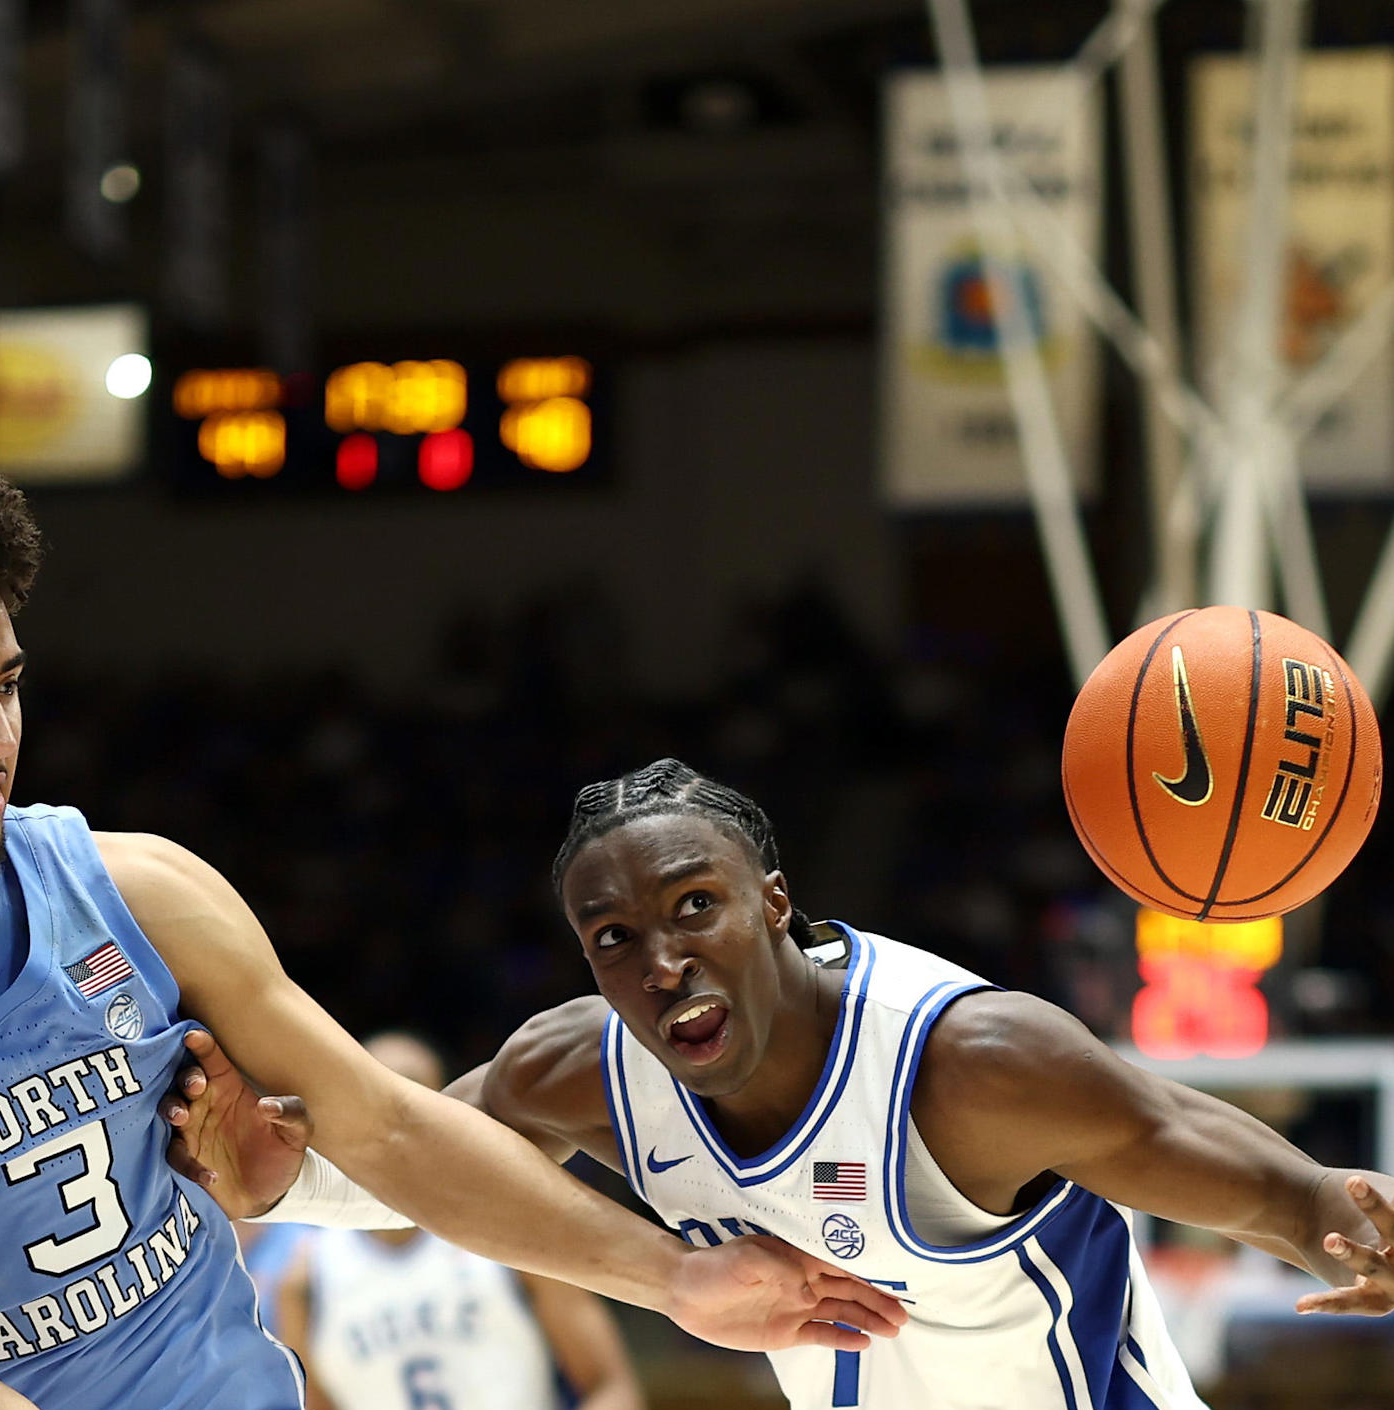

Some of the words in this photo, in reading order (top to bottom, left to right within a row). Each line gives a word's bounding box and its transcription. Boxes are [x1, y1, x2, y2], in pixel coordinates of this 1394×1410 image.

[1261, 658, 1325, 828] ELITE
[2, 1118, 132, 1277] 3
[828, 1229, 861, 1241] ACC
